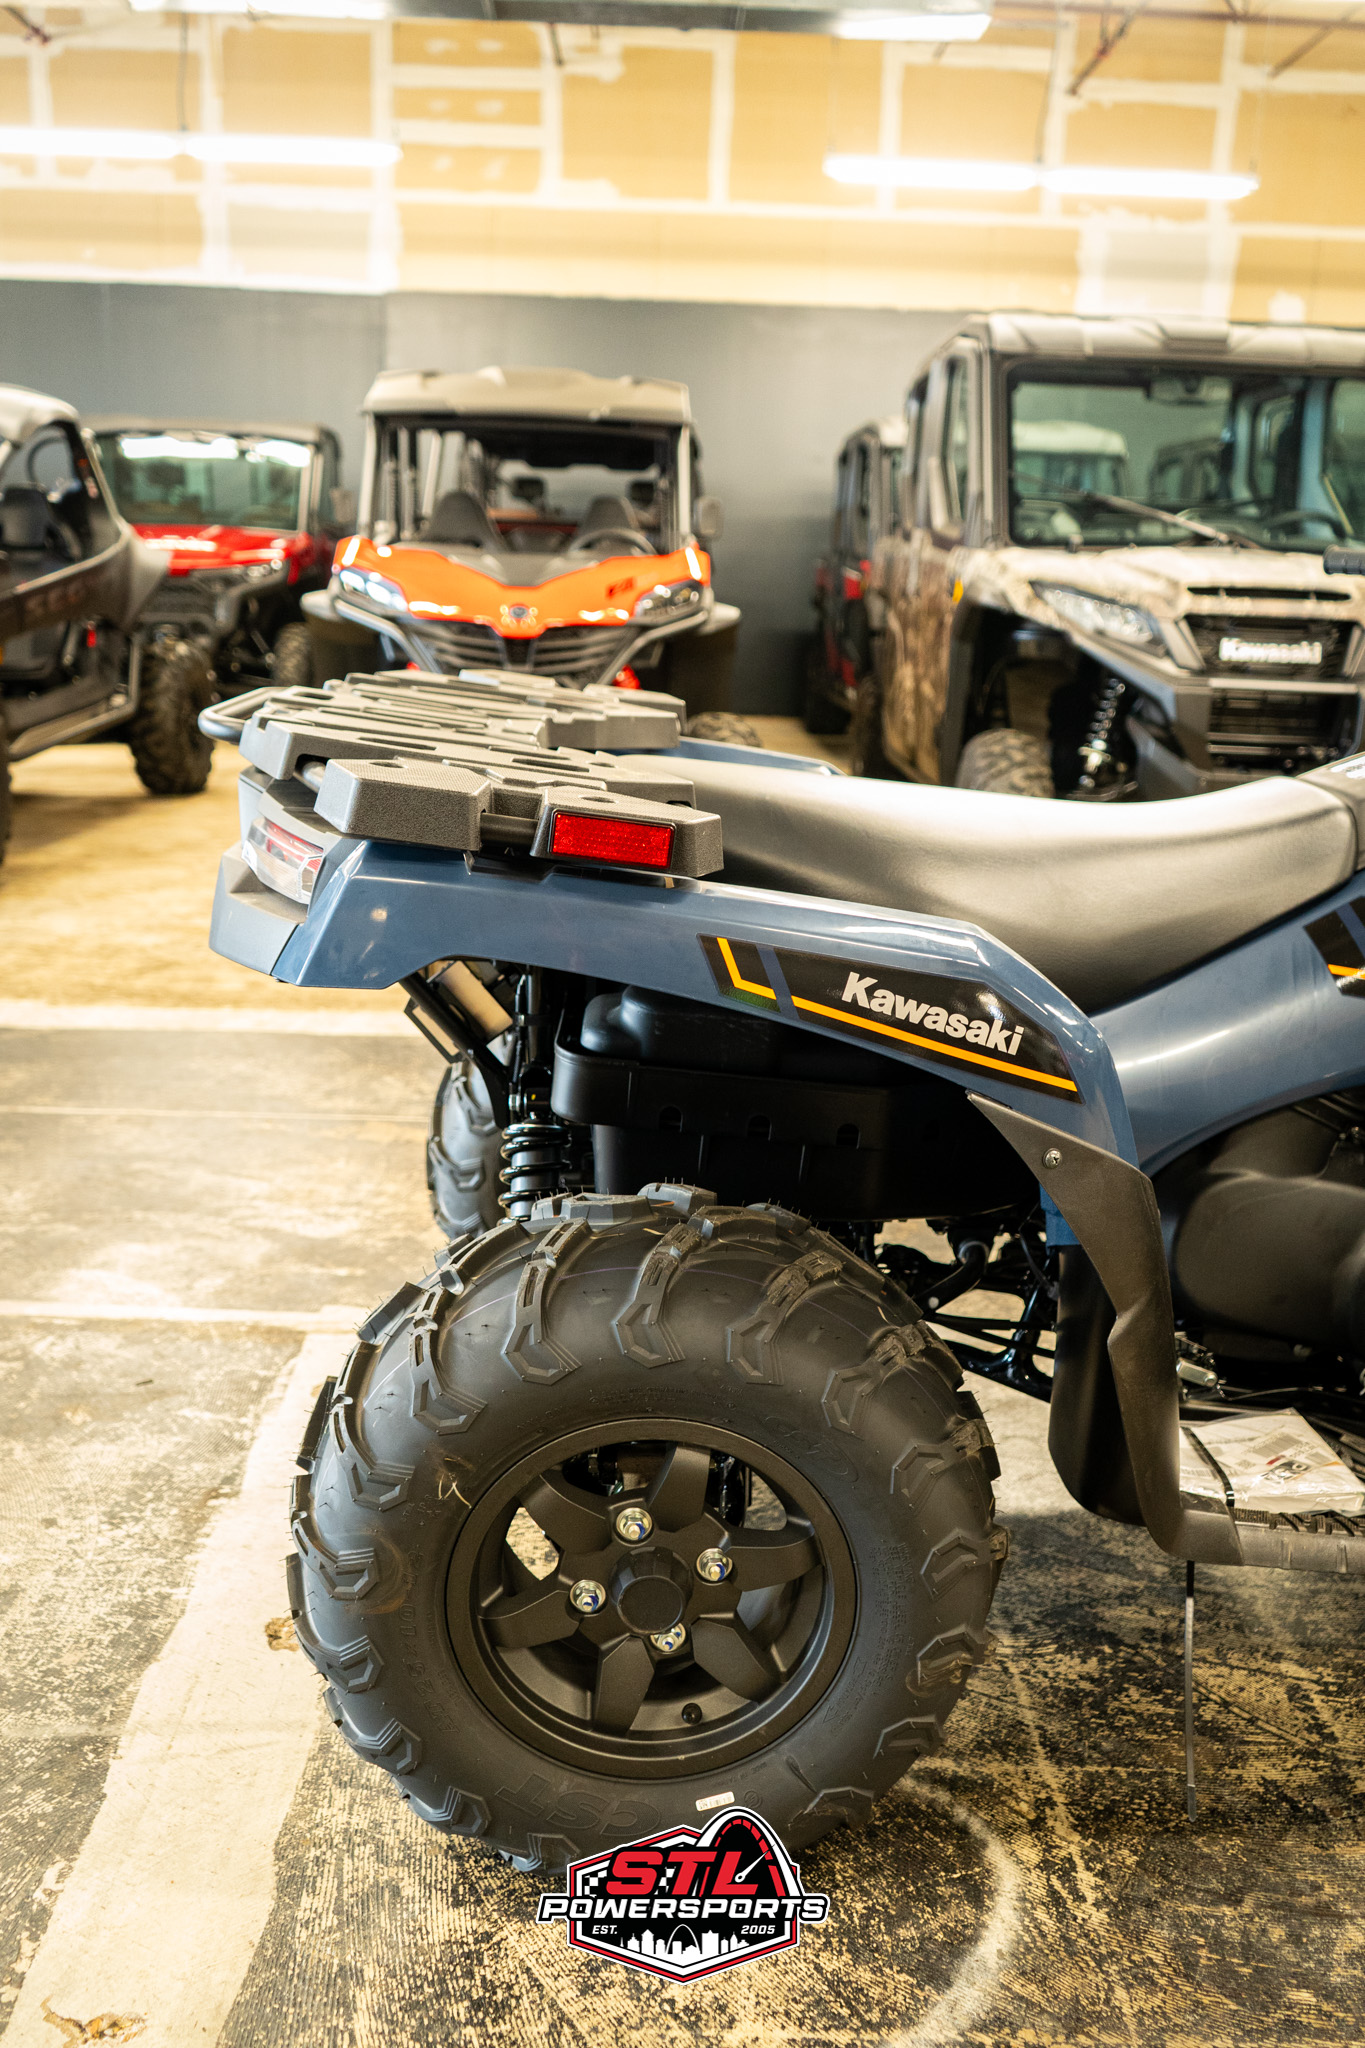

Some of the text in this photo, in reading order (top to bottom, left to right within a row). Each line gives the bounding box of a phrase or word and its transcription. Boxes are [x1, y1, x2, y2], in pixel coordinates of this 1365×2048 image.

[1219, 637, 1322, 664] Kawasaki
[841, 971, 1025, 1056] Kawasaki
[495, 1772, 661, 1836] CST
